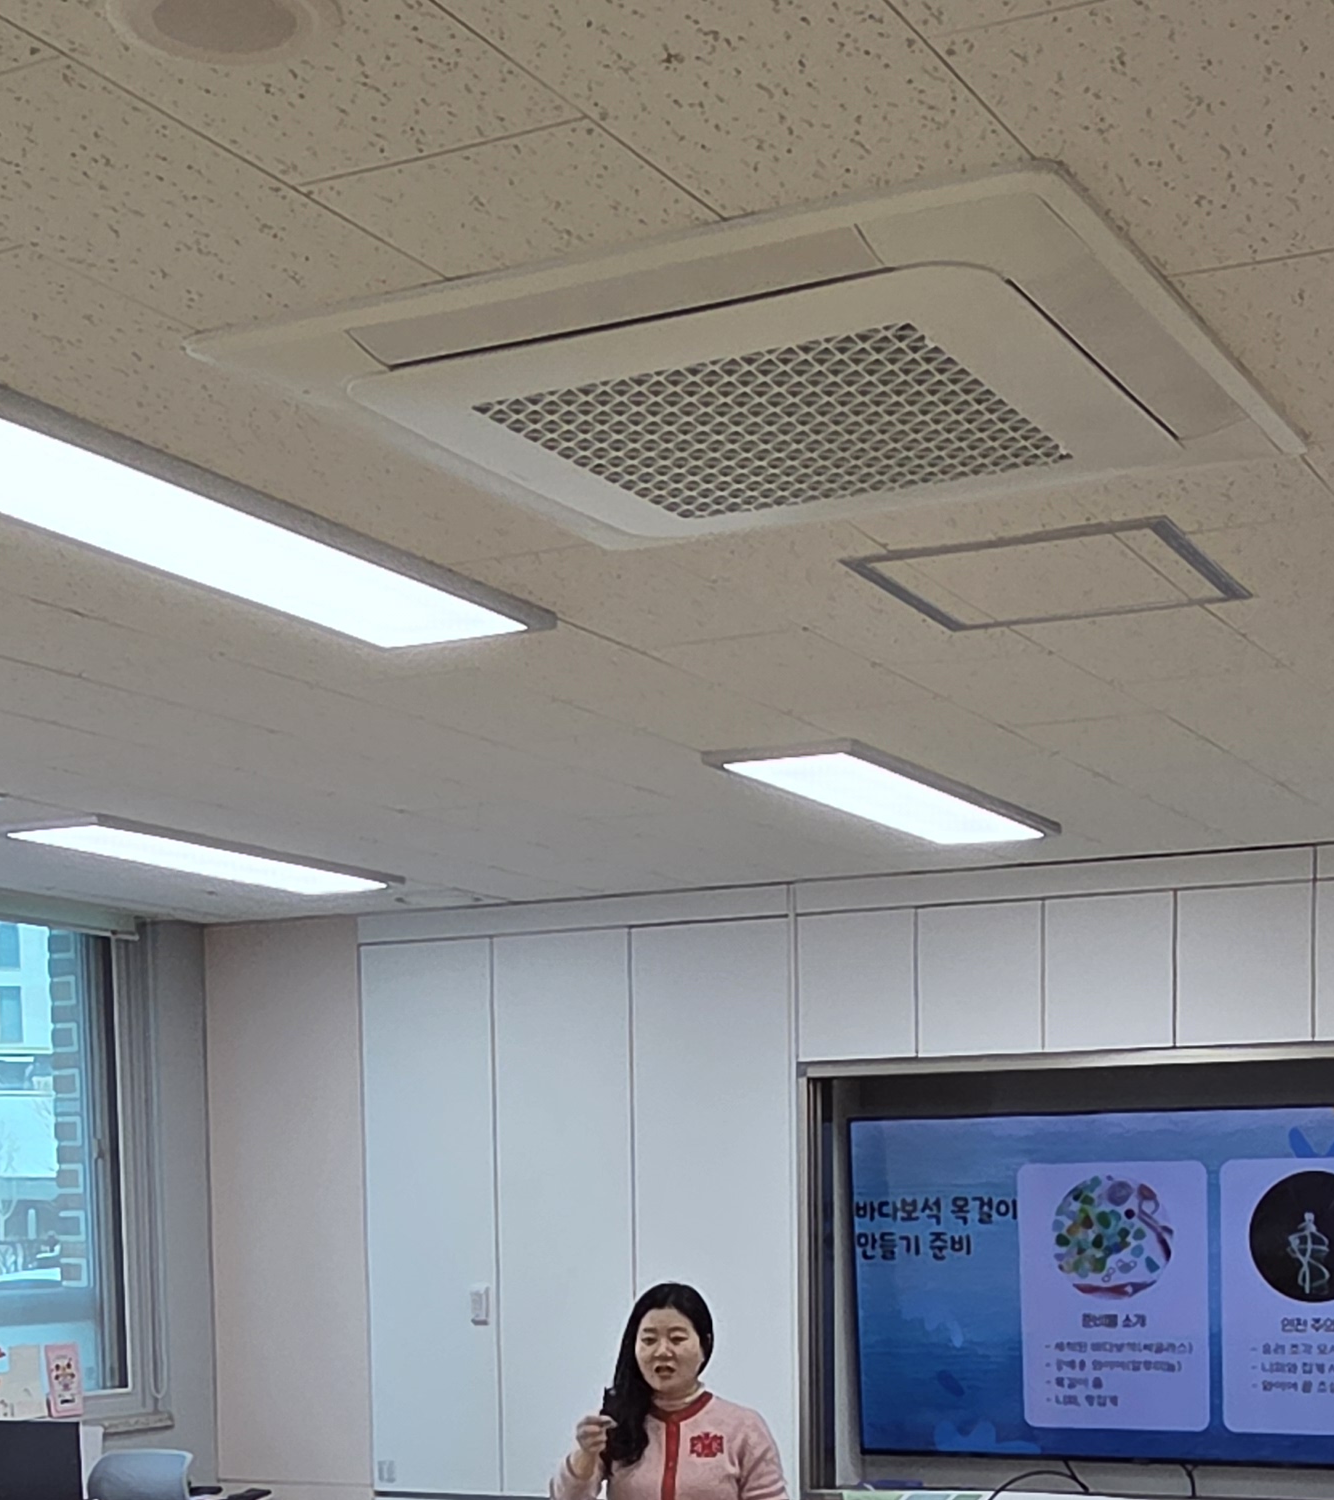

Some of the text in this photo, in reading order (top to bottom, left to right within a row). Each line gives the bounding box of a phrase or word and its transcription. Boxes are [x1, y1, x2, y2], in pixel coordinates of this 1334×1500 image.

[855, 1196, 1018, 1226] 바다보석 목걸이
[857, 1231, 972, 1261] 만들기 준비
